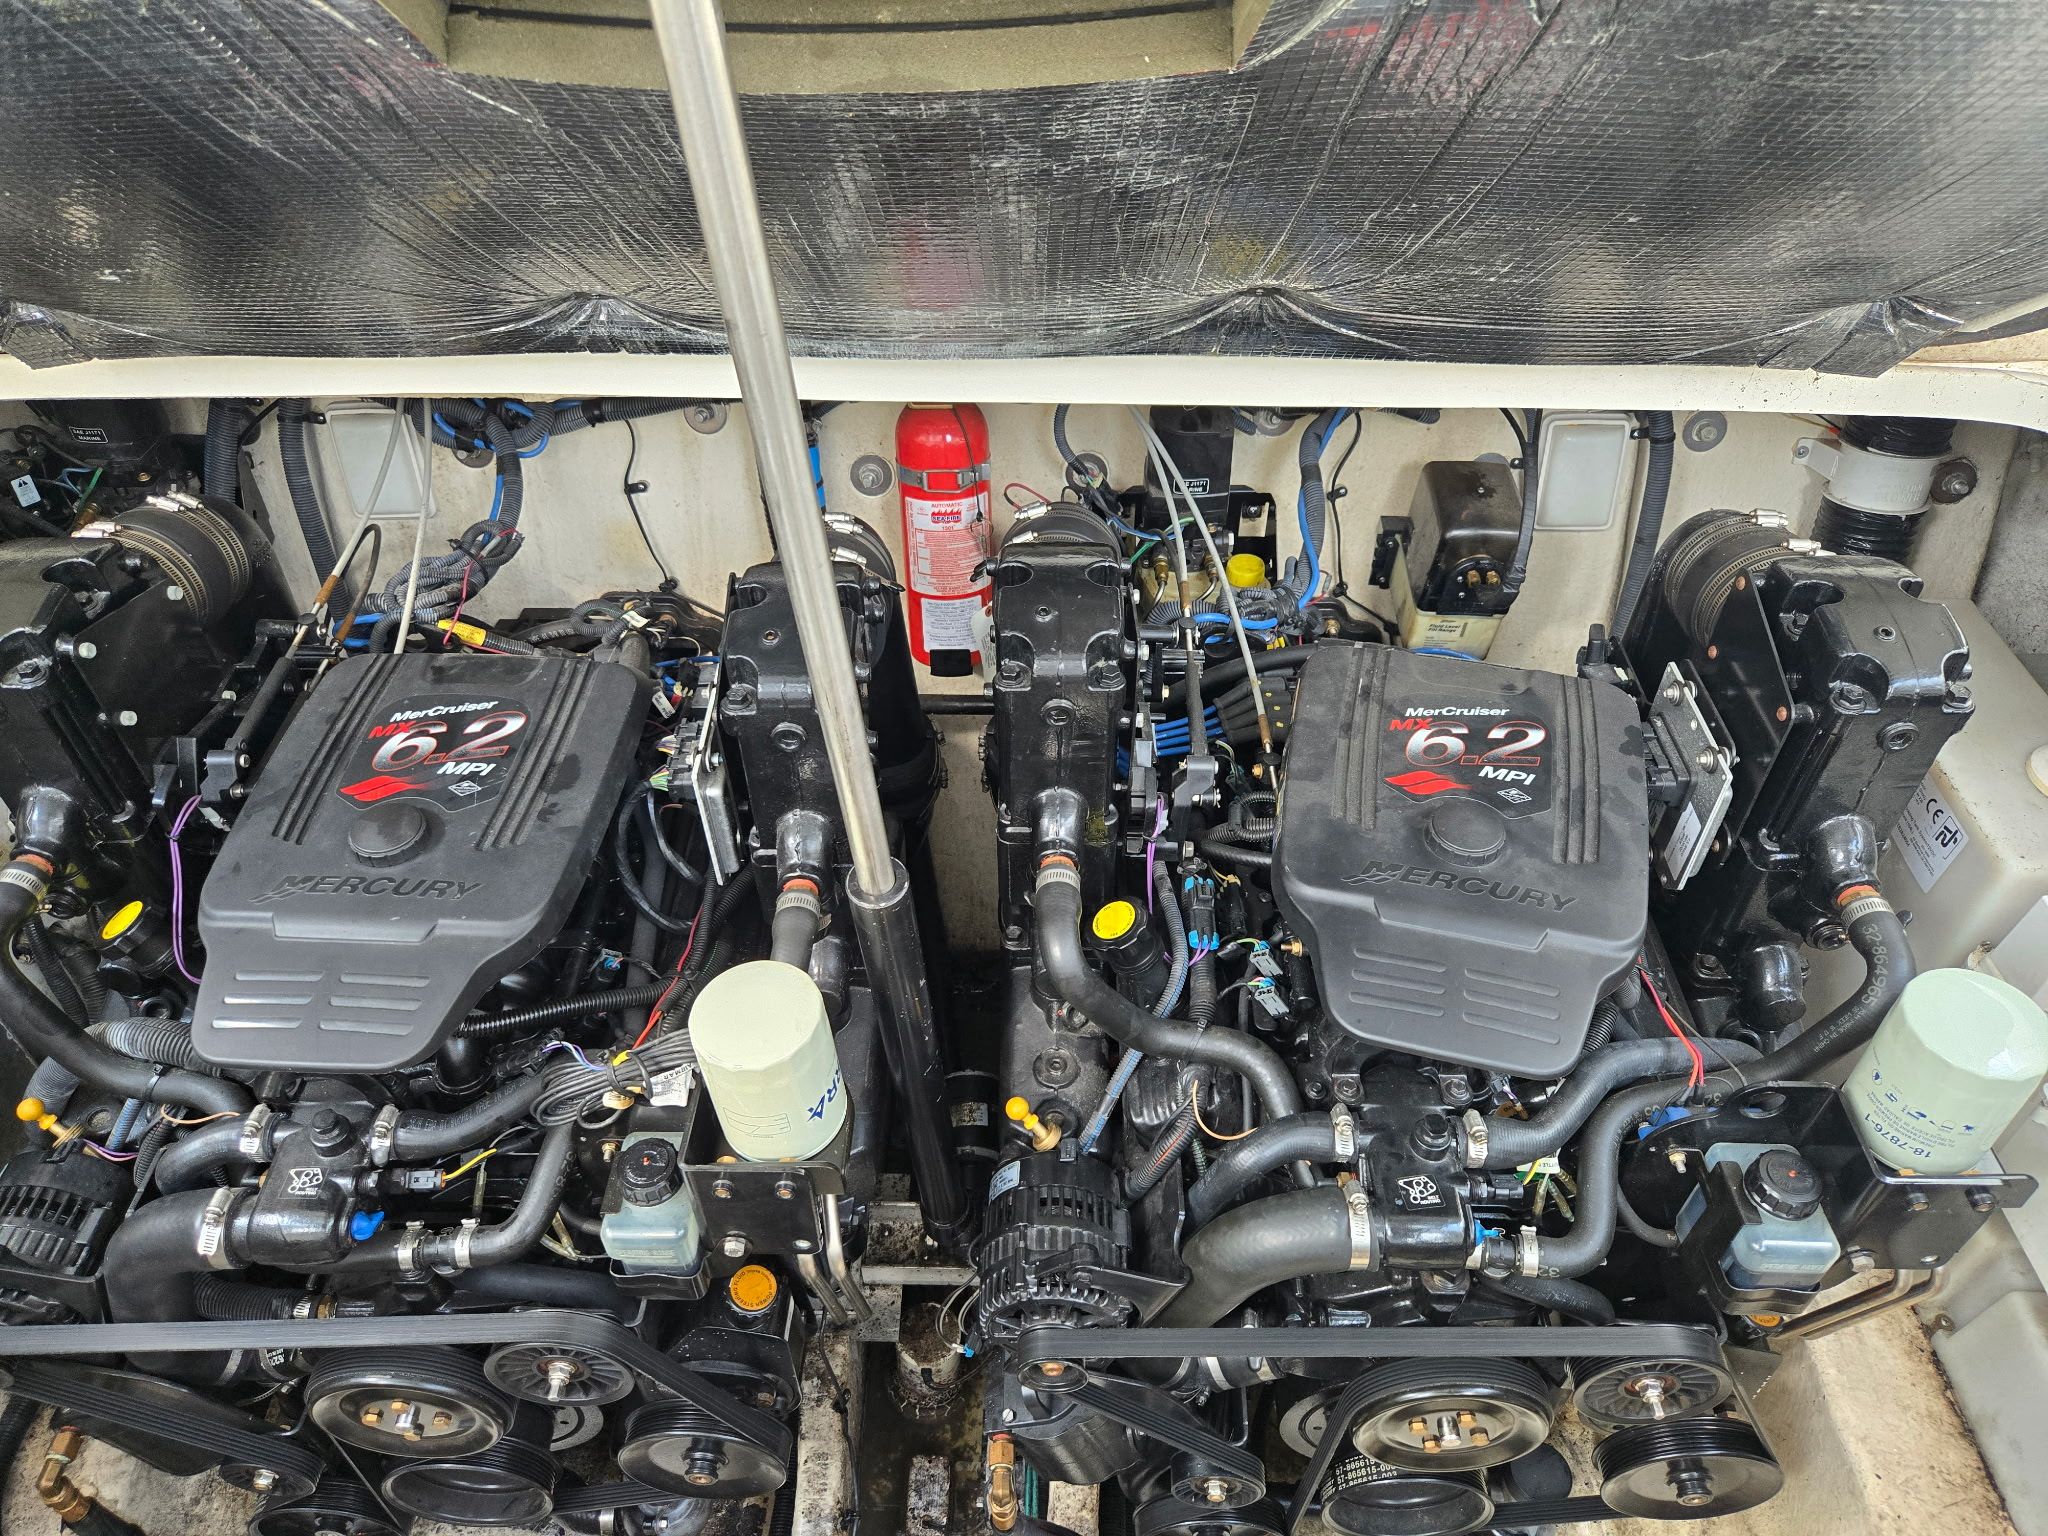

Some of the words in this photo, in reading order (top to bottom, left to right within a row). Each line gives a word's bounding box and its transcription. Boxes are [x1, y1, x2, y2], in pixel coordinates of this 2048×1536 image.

[390, 701, 499, 723] MerCruiser
[1405, 706, 1510, 717] MerCruiser
[368, 721, 416, 738] MX
[1389, 718, 1432, 731] MX
[372, 711, 527, 771] 6.2
[1405, 720, 1546, 767] 6.2
[437, 762, 497, 776] MPI
[1478, 765, 1536, 785] MPI
[250, 875, 482, 905] MERCURY
[1341, 860, 1577, 913] MERCURY
[1862, 923, 1889, 1007] 32-864965
[663, 1062, 692, 1080] AIRMAR
[1864, 1113, 1932, 1158] 18-7876-1
[1894, 1126, 1911, 1140] MARINE
[1899, 1123, 1918, 1137] MARINE
[1911, 1125, 1929, 1136] ACEITE
[1912, 1136, 1935, 1148] PREMIUM
[733, 1271, 746, 1286] FLUID
[733, 1287, 754, 1308] STEERING
[755, 1291, 773, 1307] POWER
